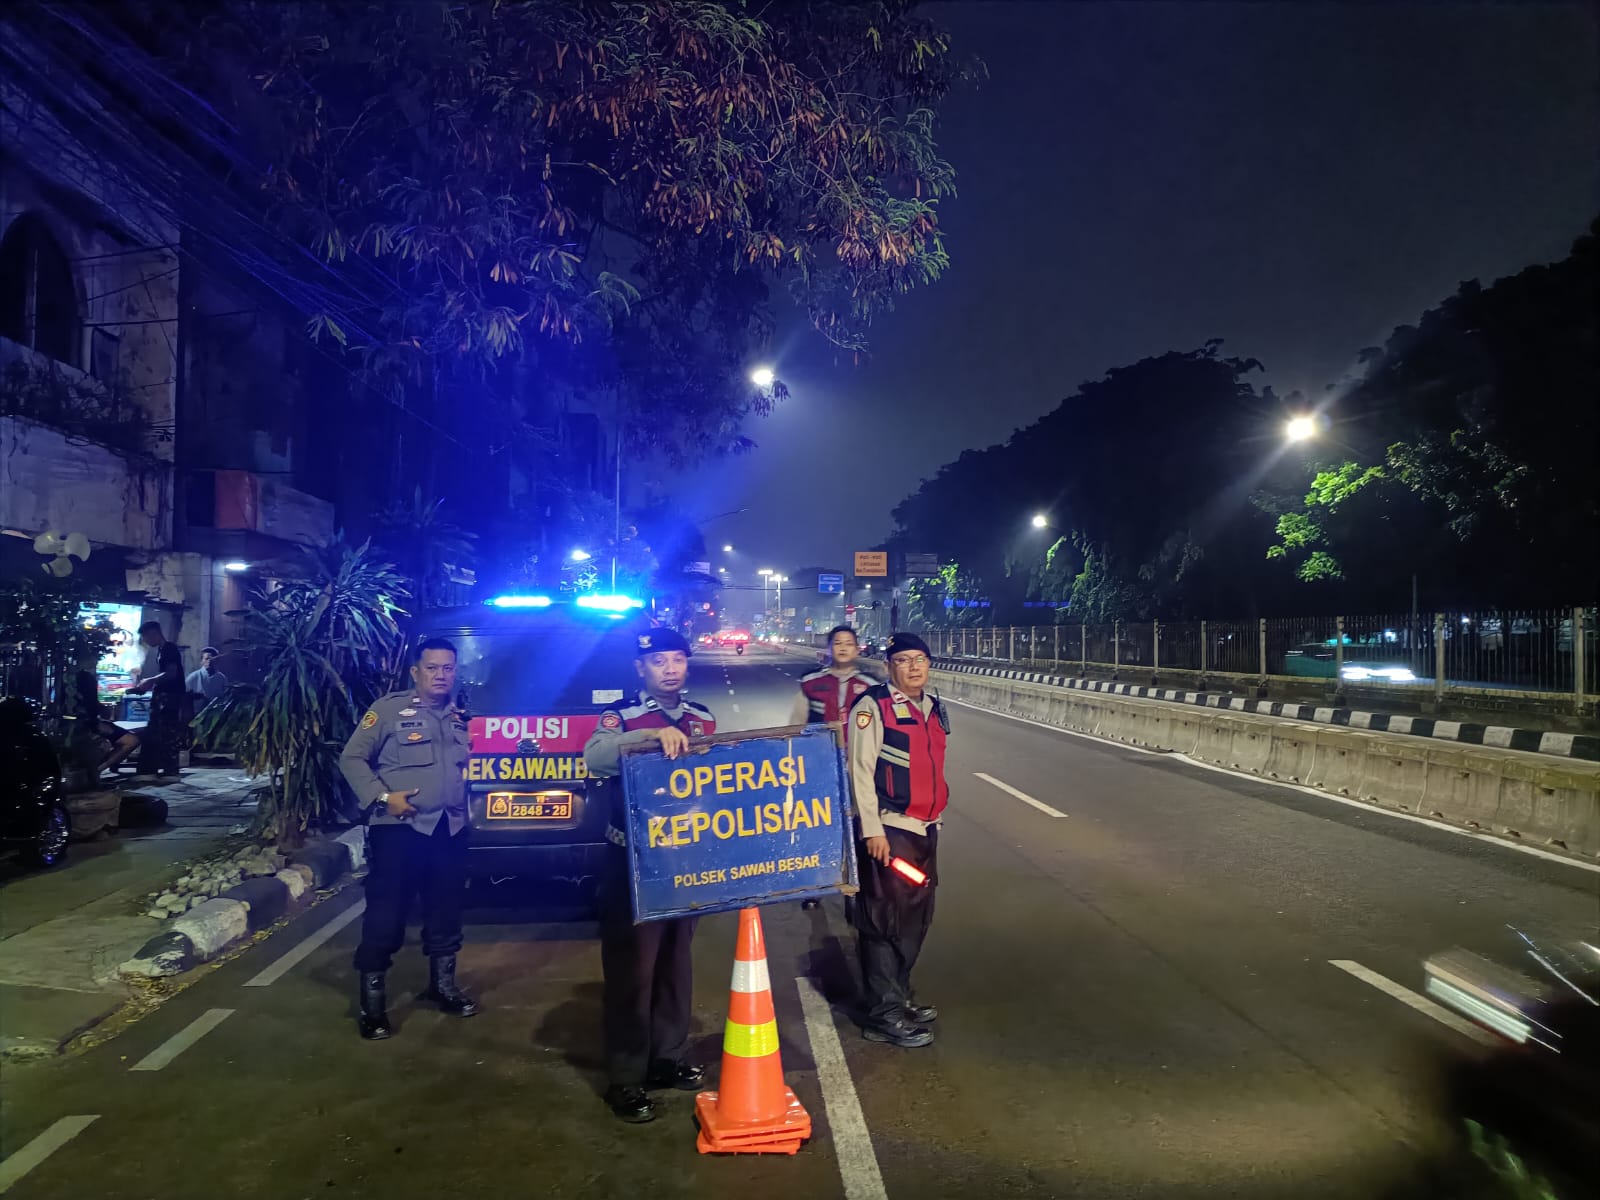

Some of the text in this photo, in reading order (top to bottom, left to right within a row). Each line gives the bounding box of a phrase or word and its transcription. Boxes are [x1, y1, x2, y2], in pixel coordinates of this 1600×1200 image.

[485, 717, 569, 739] POLISI
[499, 757, 573, 780] SAWAH
[669, 755, 806, 798] OPERASI
[647, 796, 832, 848] KEPOLISIAN
[673, 854, 820, 889] POLSEK SAWAH BESAR
